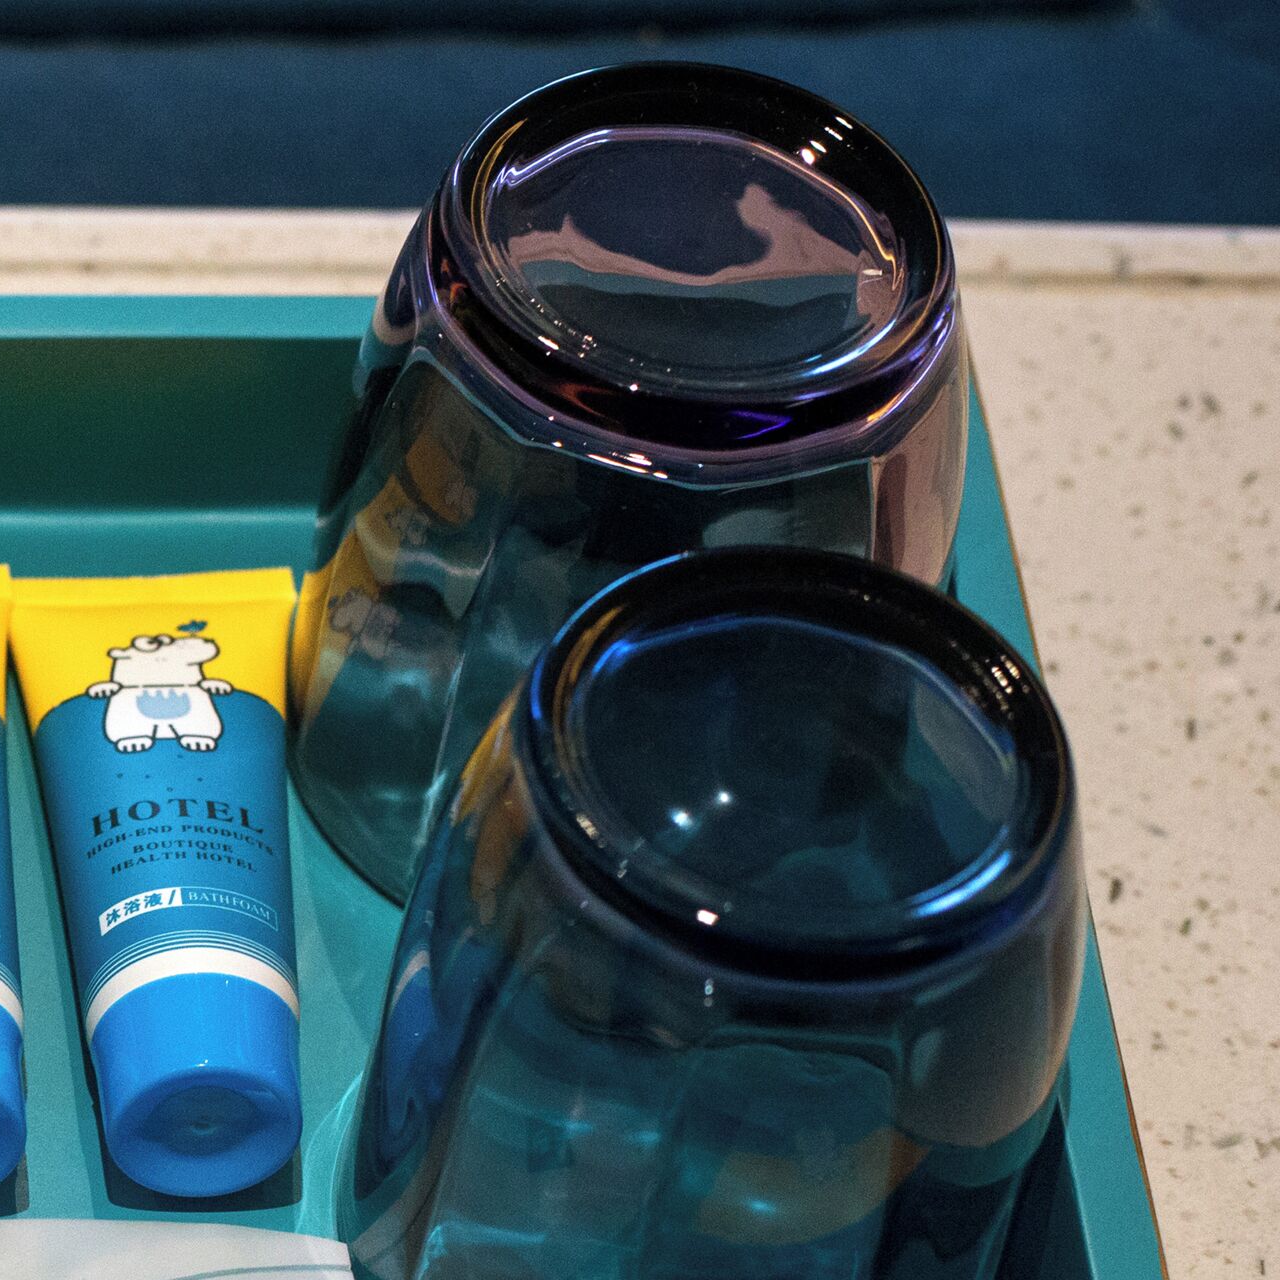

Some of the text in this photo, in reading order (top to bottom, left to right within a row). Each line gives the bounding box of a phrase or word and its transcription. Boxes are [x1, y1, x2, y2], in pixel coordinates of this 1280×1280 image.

[91, 798, 263, 837] HOTEL
[87, 824, 273, 859] HIGH-END PRODUCTS
[133, 840, 233, 854] BOUTIQUE
[111, 852, 257, 875] HEALTH HOTEL
